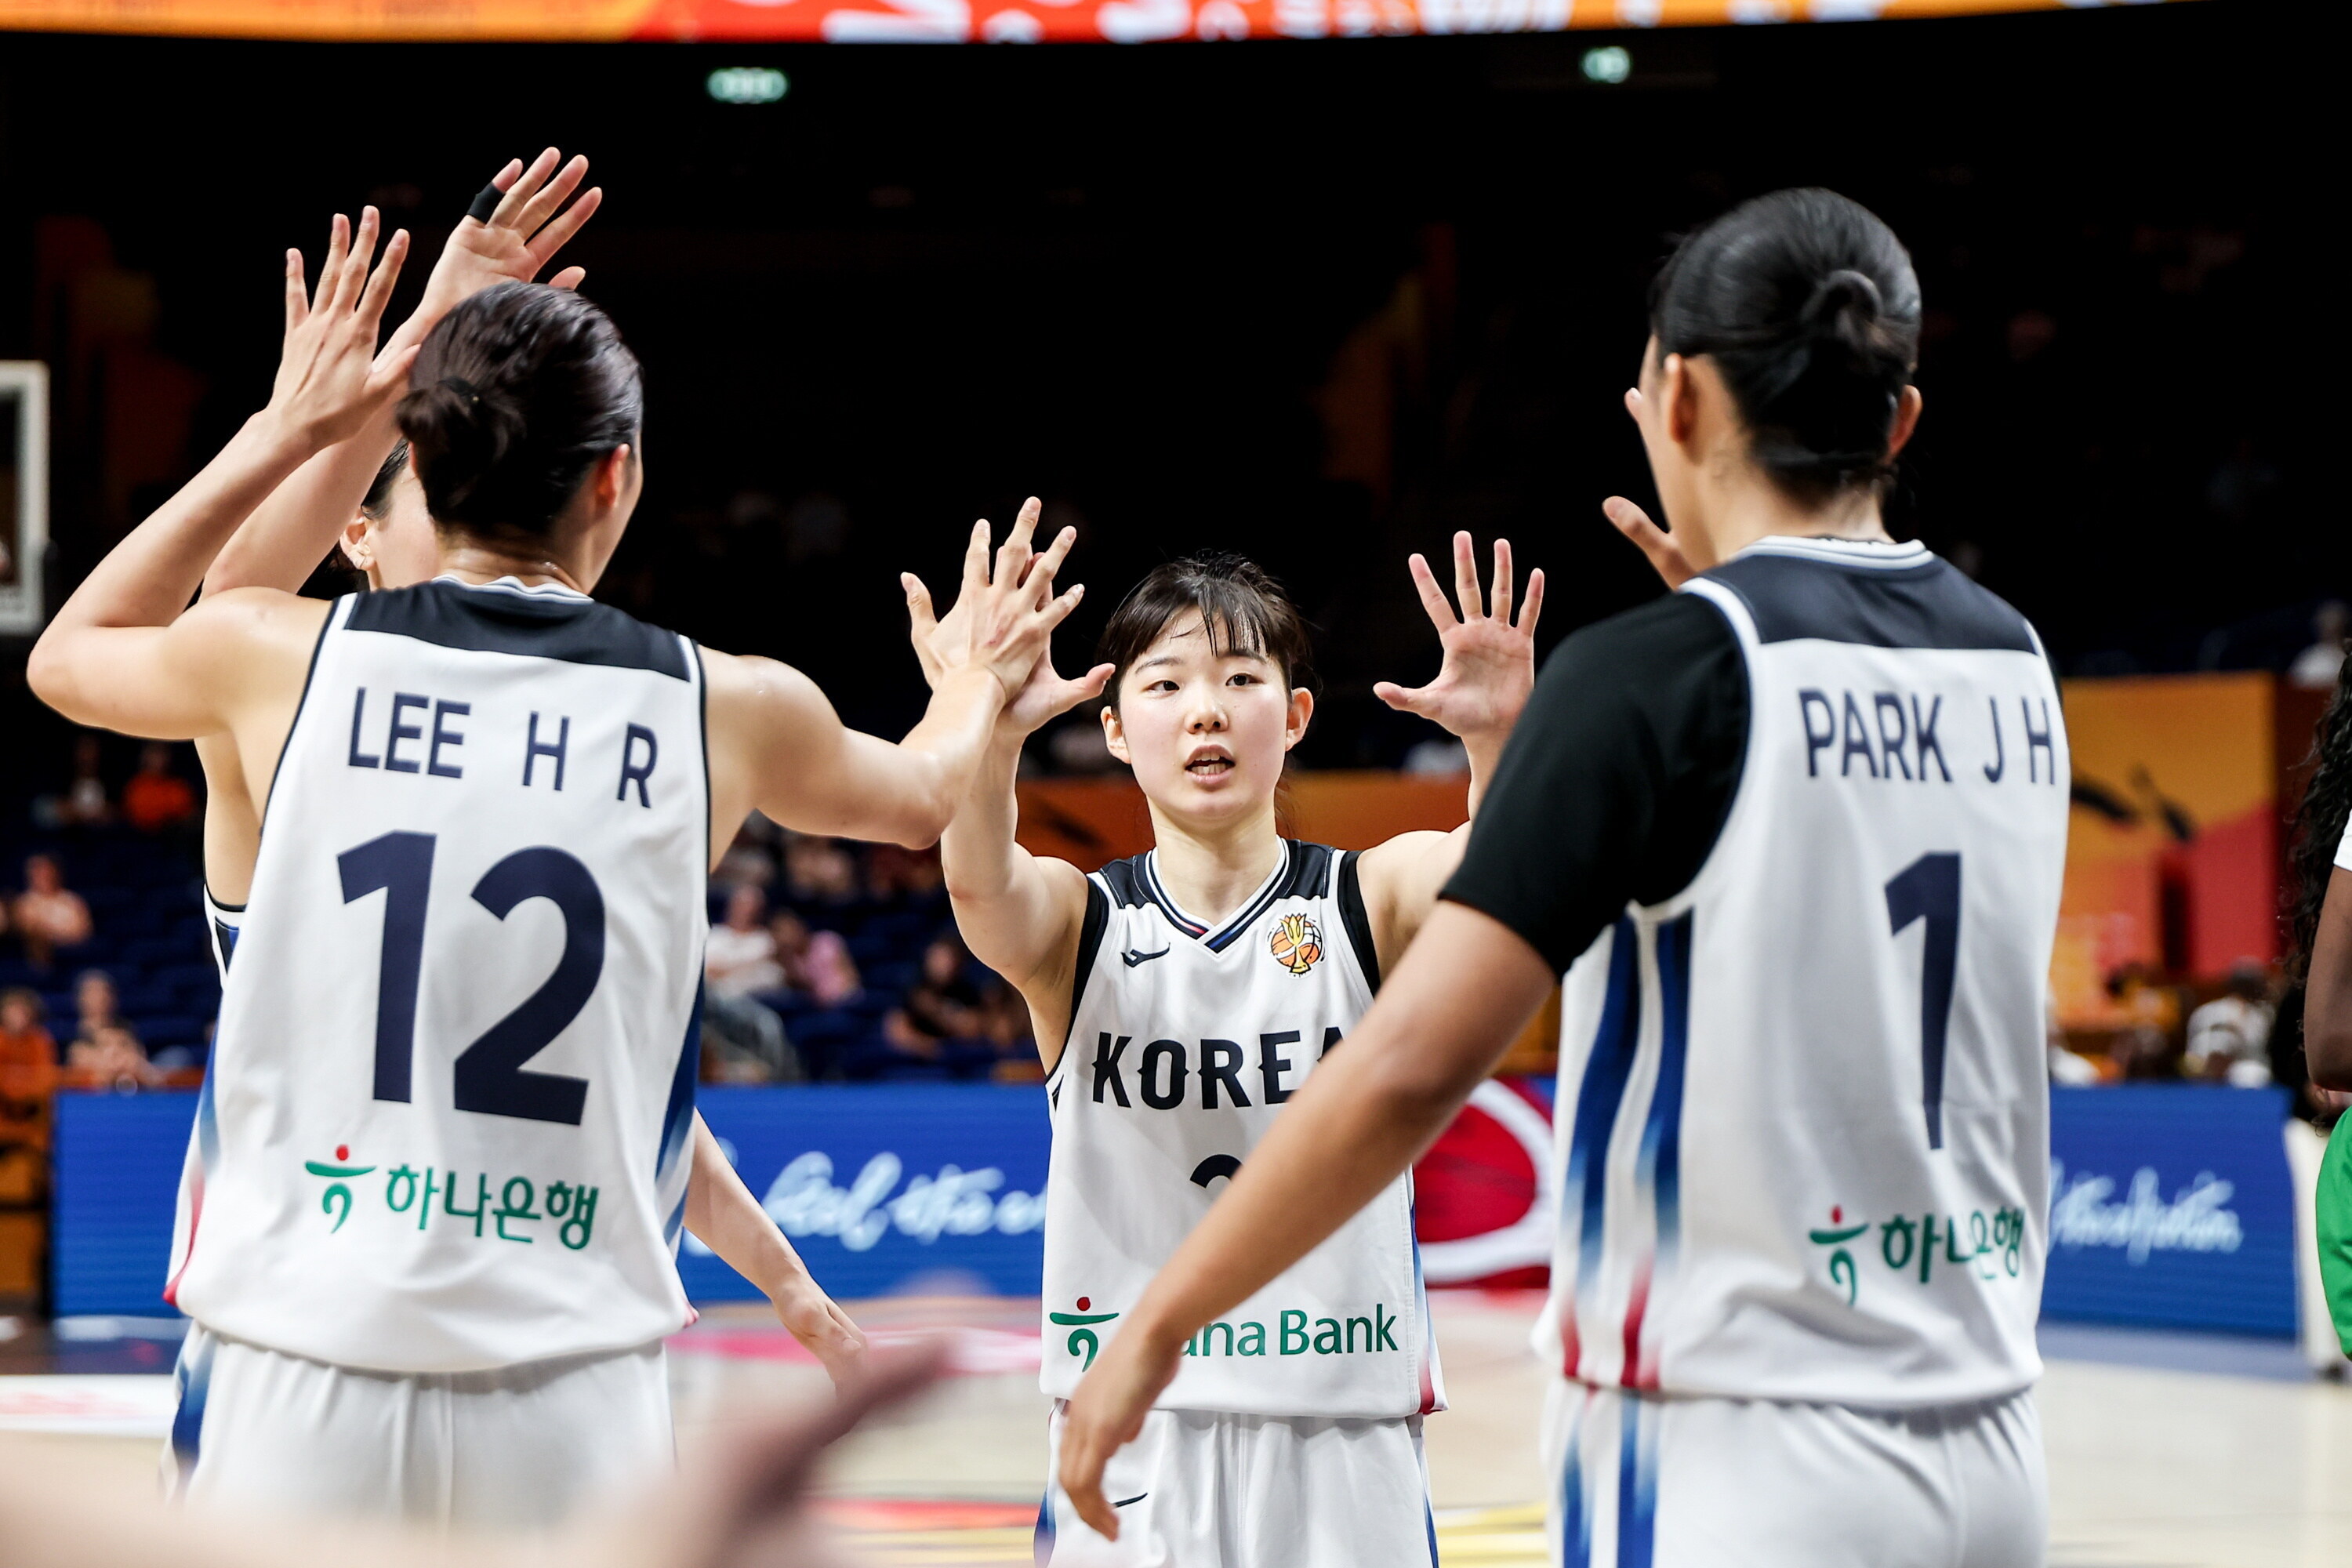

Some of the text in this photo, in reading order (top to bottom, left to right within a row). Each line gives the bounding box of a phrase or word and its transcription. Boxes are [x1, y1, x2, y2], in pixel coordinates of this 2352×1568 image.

[347, 686, 659, 810] LEE H R
[1798, 688, 2056, 786] PARK J H
[336, 830, 607, 1128] 12
[1884, 851, 1963, 1151] 1
[386, 1163, 600, 1250] 하나은행
[1279, 1302, 1399, 1356] Bank
